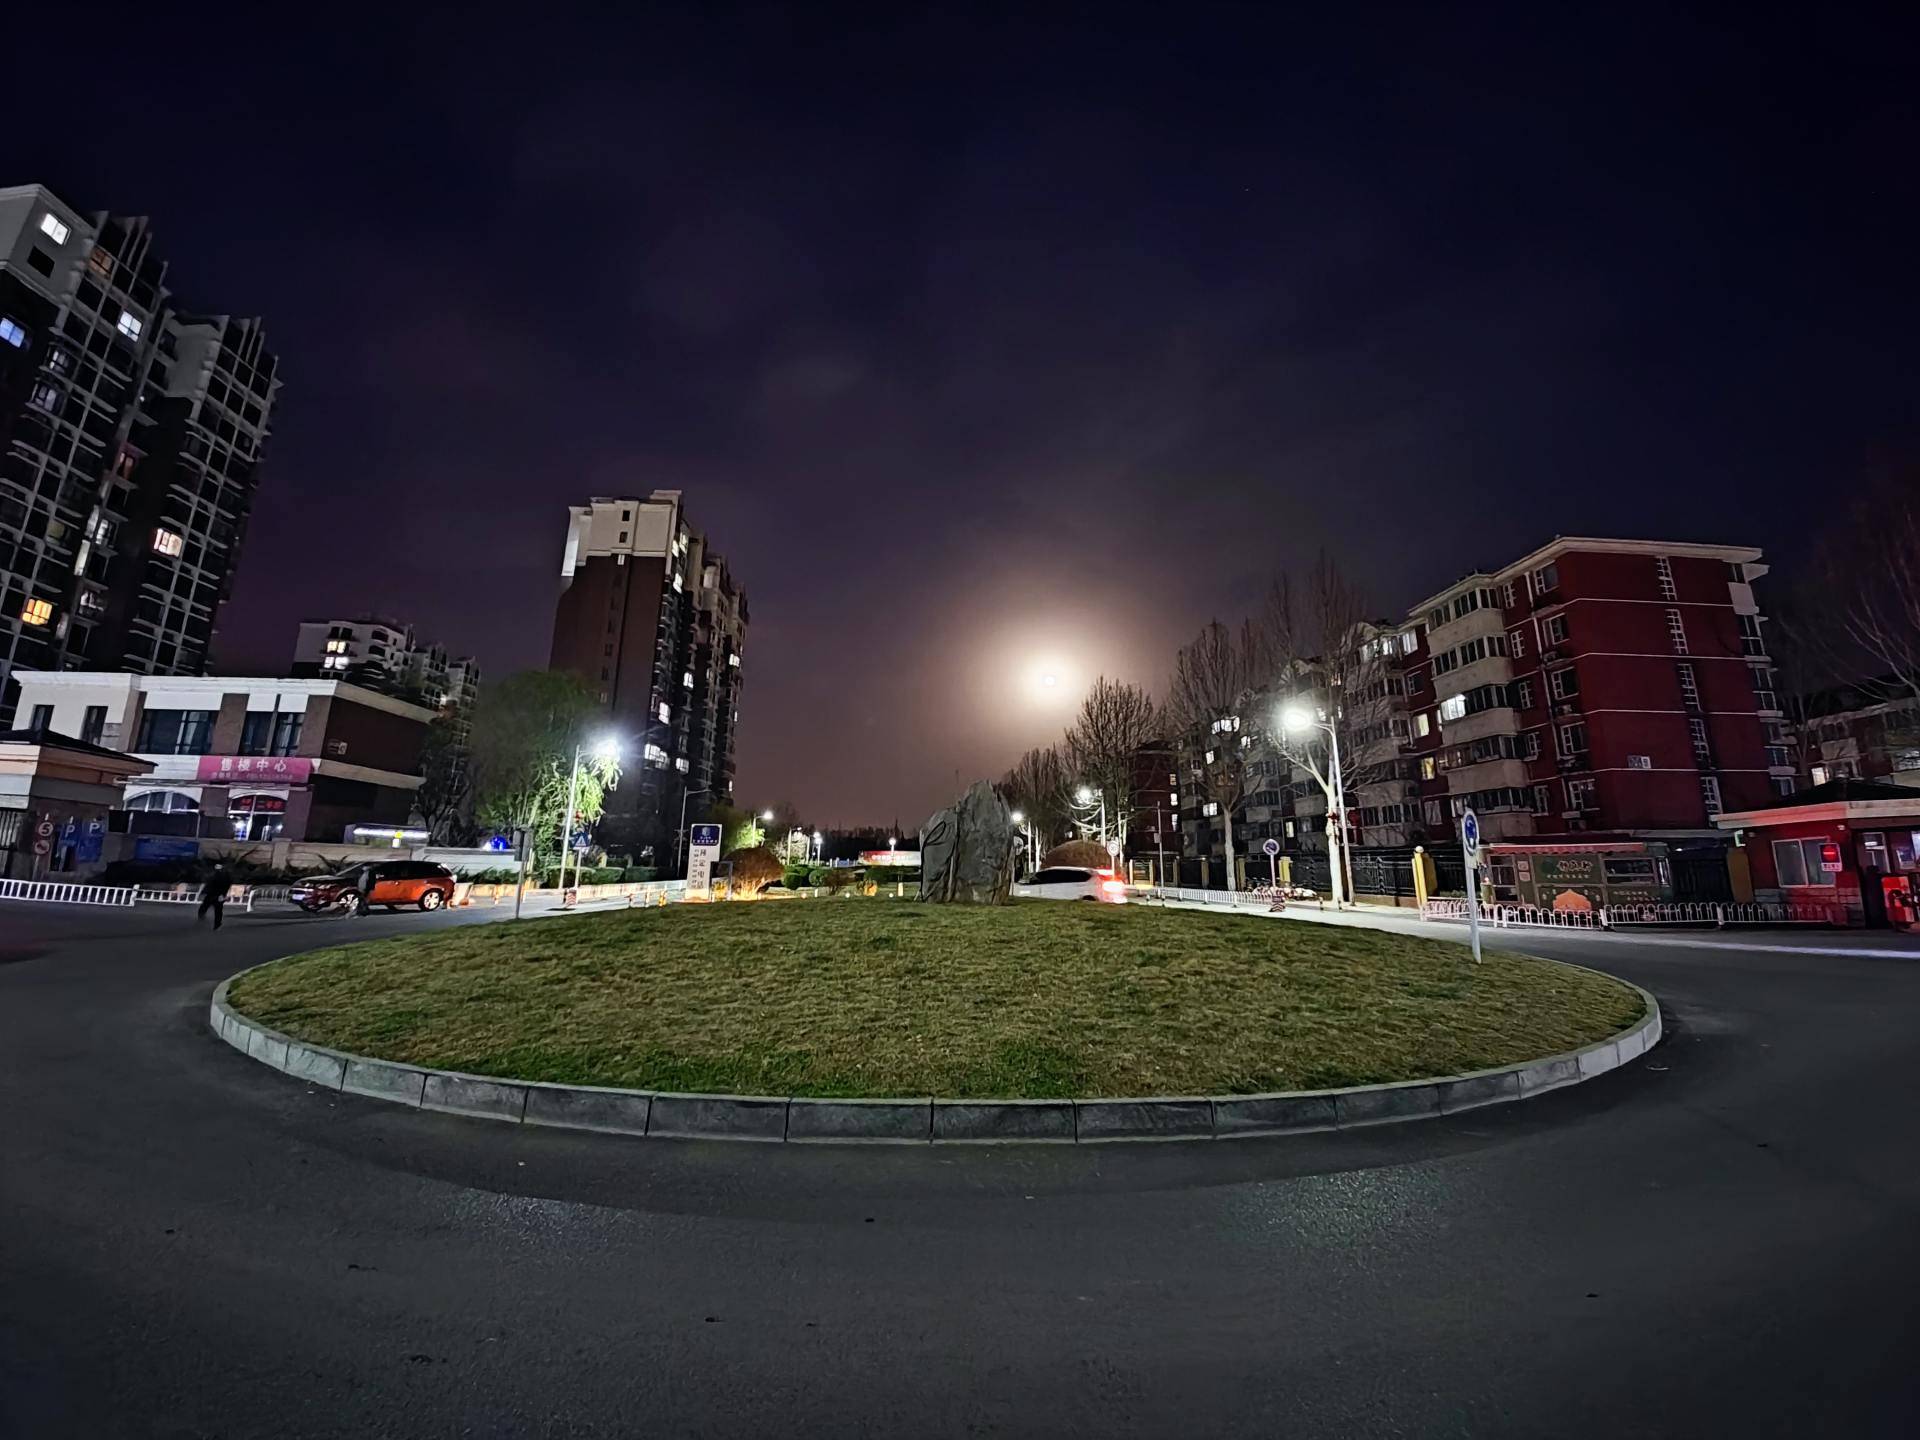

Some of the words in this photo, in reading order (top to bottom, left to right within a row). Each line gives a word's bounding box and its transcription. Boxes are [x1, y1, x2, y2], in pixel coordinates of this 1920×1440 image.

[221, 757, 287, 773] 售楼中心
[65, 824, 76, 838] P
[89, 822, 100, 834] P
